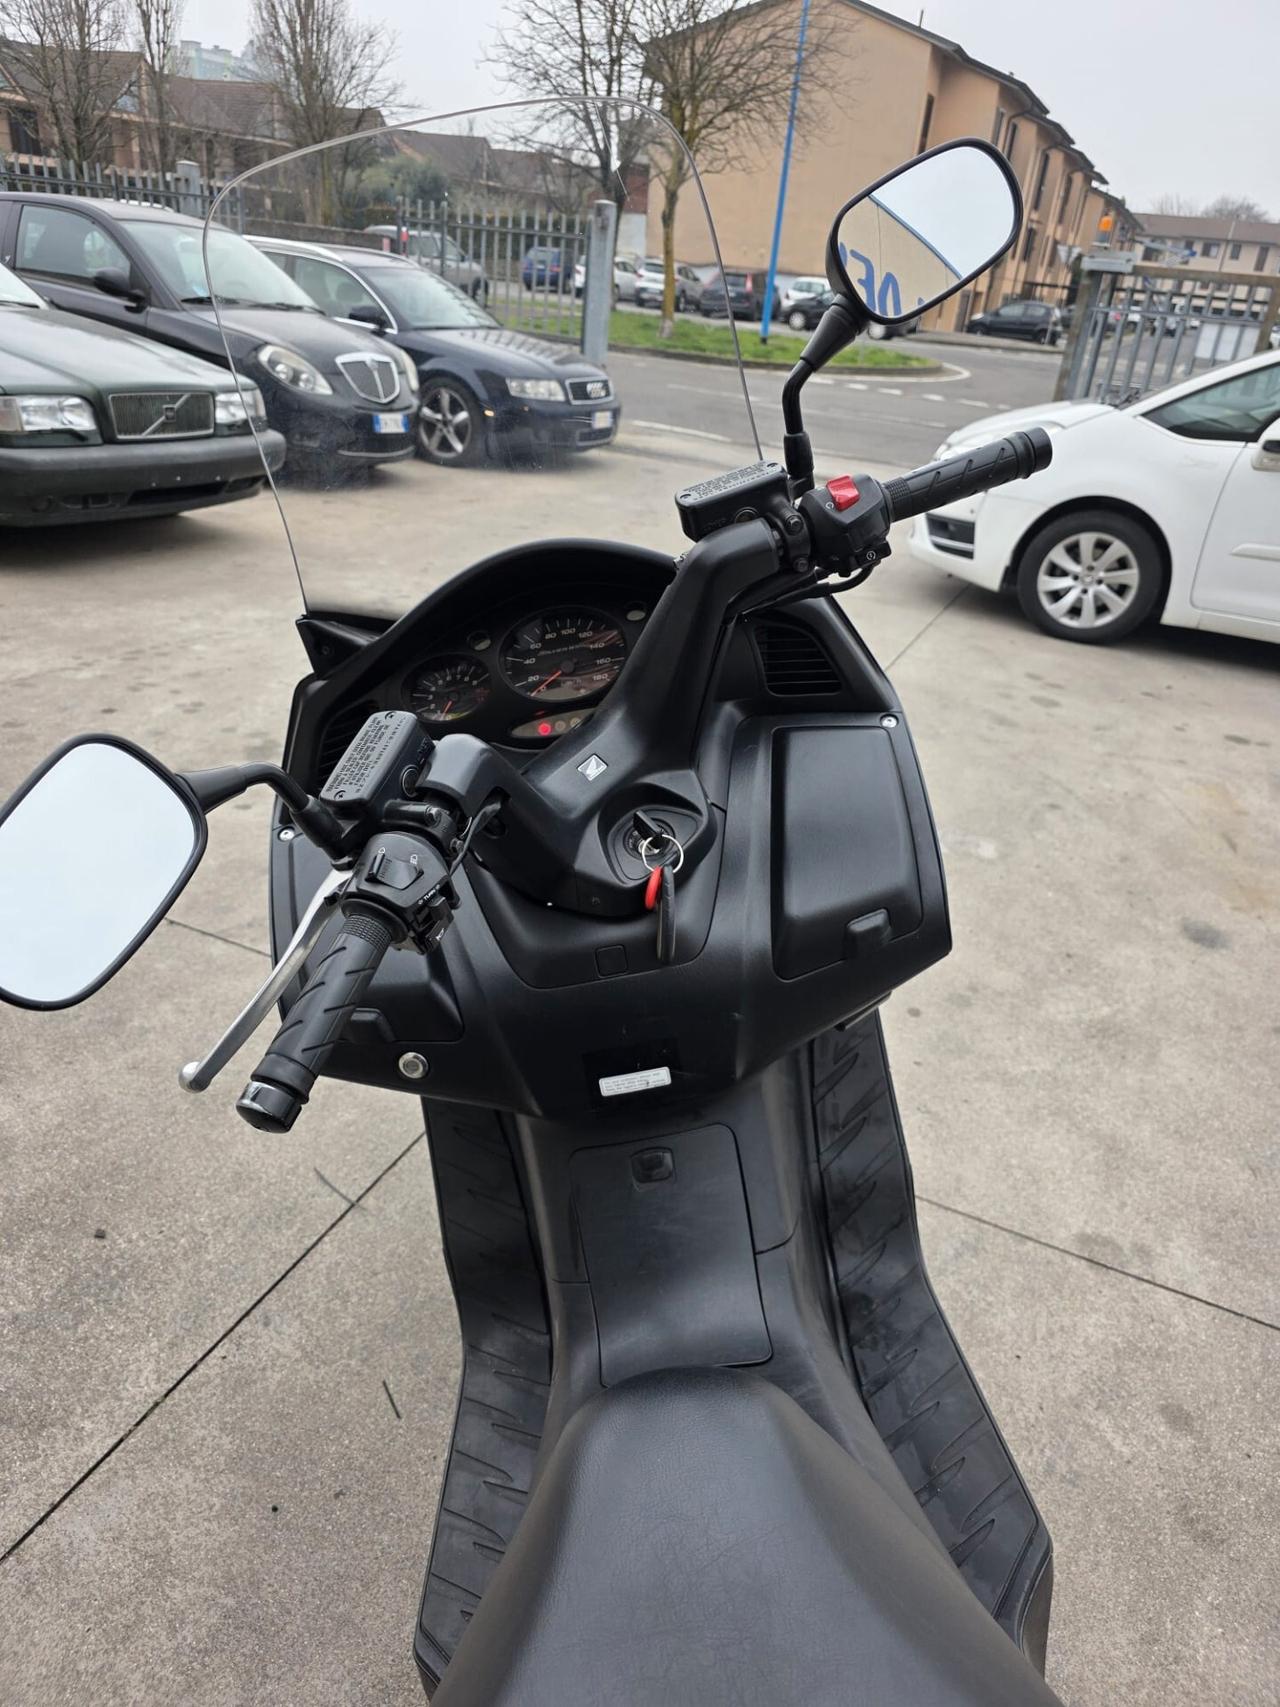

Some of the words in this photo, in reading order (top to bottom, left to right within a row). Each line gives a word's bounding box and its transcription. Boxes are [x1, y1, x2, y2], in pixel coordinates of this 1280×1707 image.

[560, 627, 576, 635] 100
[578, 630, 593, 638] 120
[530, 642, 542, 650] 60
[597, 657, 611, 665] 160
[527, 674, 540, 682] 20
[593, 673, 608, 681] 180
